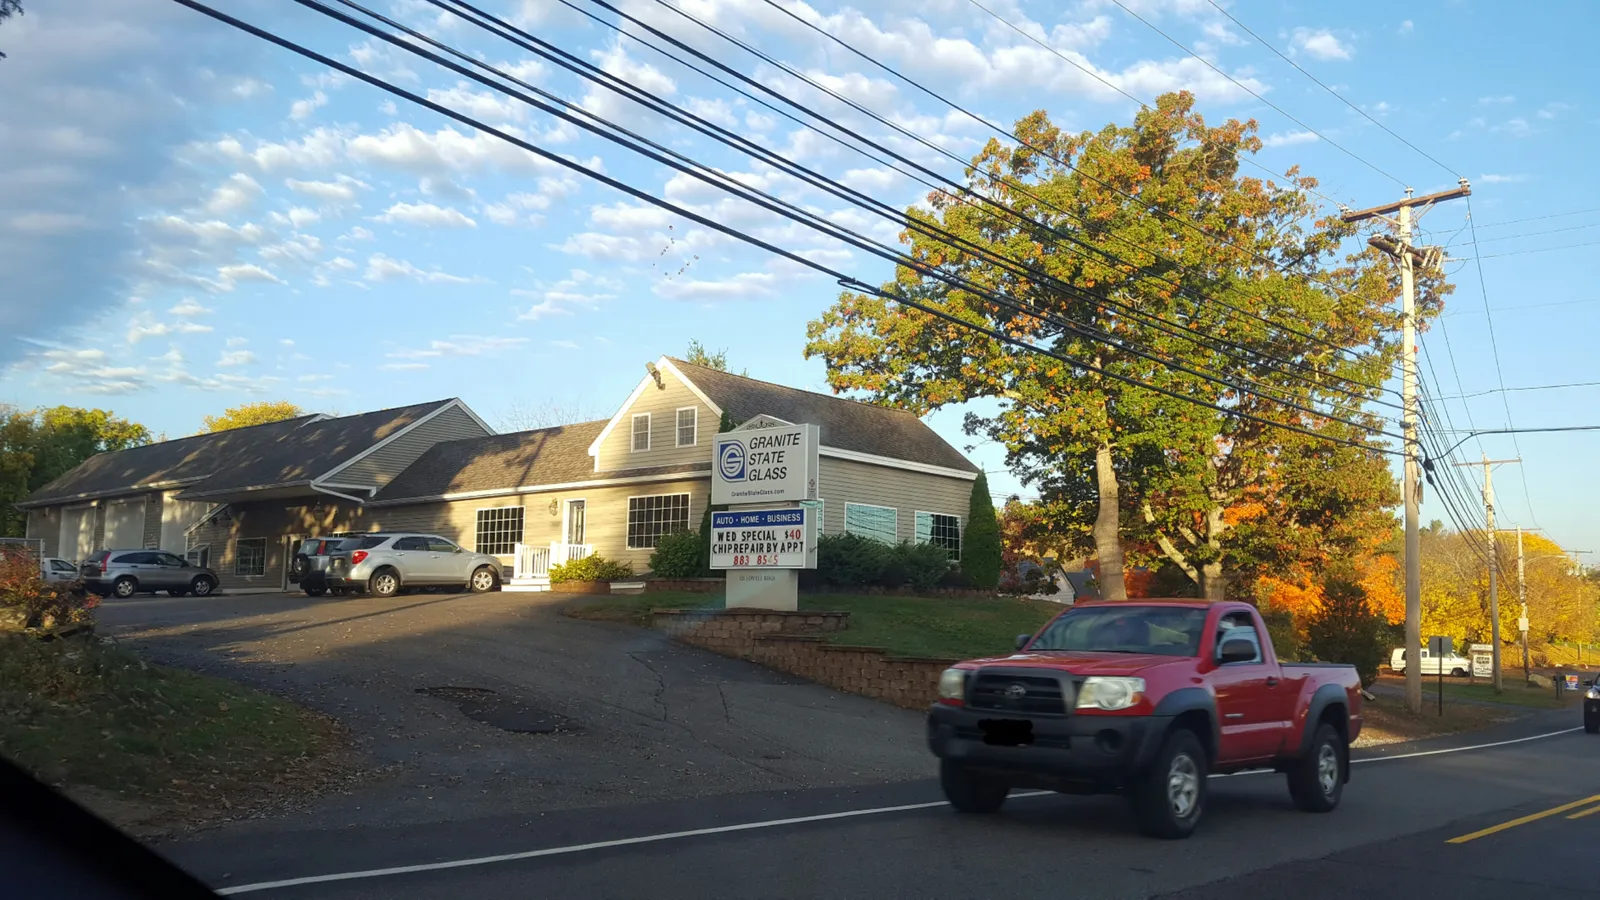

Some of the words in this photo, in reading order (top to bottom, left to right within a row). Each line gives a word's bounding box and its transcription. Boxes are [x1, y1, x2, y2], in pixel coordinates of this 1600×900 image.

[749, 432, 801, 450] GRANITE
[748, 450, 785, 466] STATE
[748, 466, 787, 482] GLASS
[731, 488, 785, 497] GraniteStateGlass.com
[716, 516, 734, 525] AUTO
[740, 515, 760, 524] HOME
[767, 513, 801, 523] BUSINESS
[717, 531, 737, 542] WED
[741, 530, 777, 541] SPECIAL
[784, 529, 801, 540] $40
[766, 542, 778, 553] BY
[780, 541, 804, 553] APPT
[733, 555, 750, 566] 883
